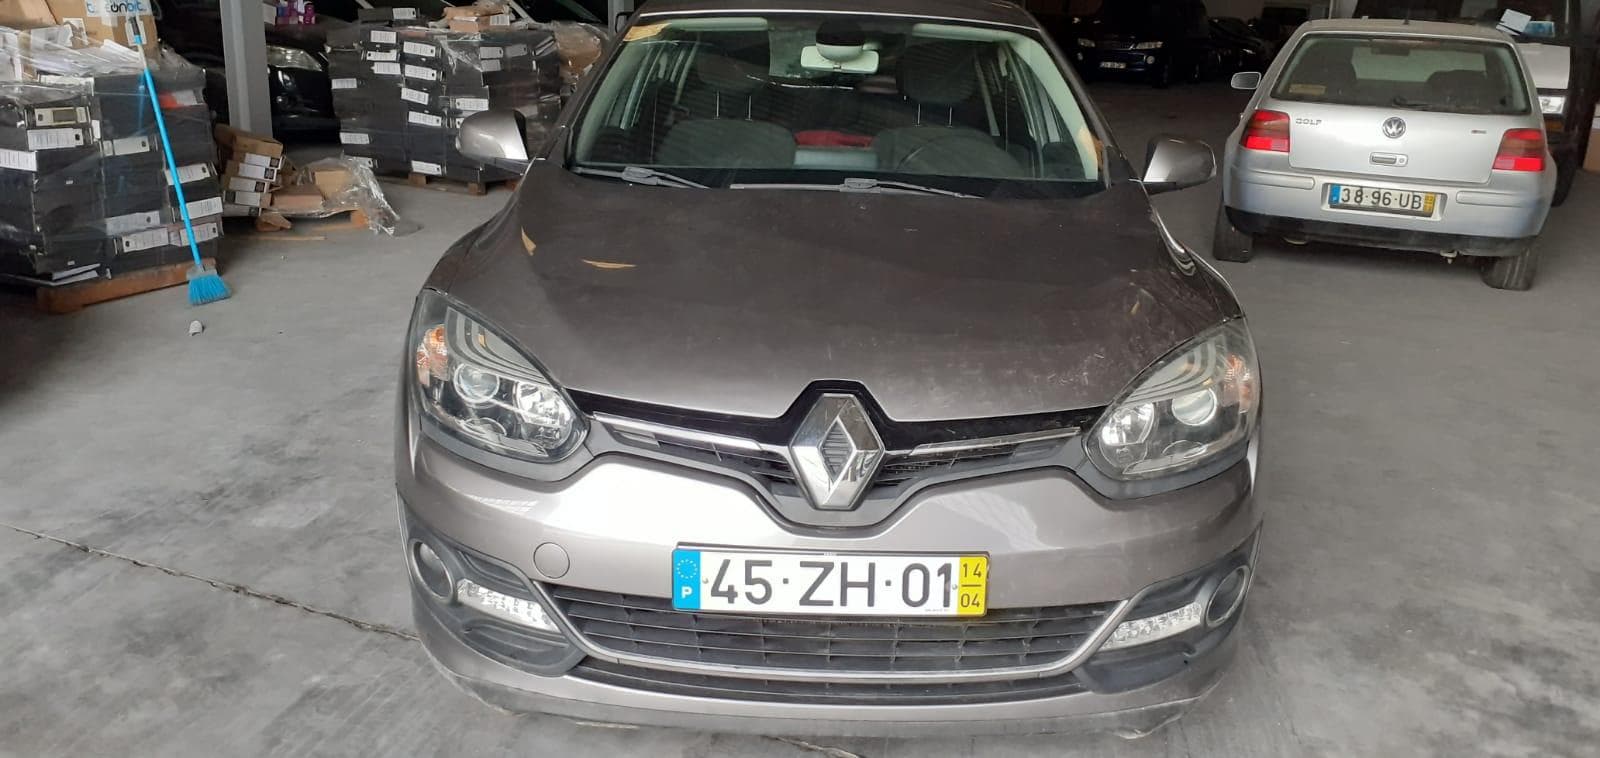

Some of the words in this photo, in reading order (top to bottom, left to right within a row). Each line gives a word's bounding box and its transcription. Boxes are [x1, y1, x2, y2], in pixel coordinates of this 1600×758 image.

[962, 562, 982, 579] 14
[681, 585, 693, 599] P
[960, 593, 980, 609] 04
